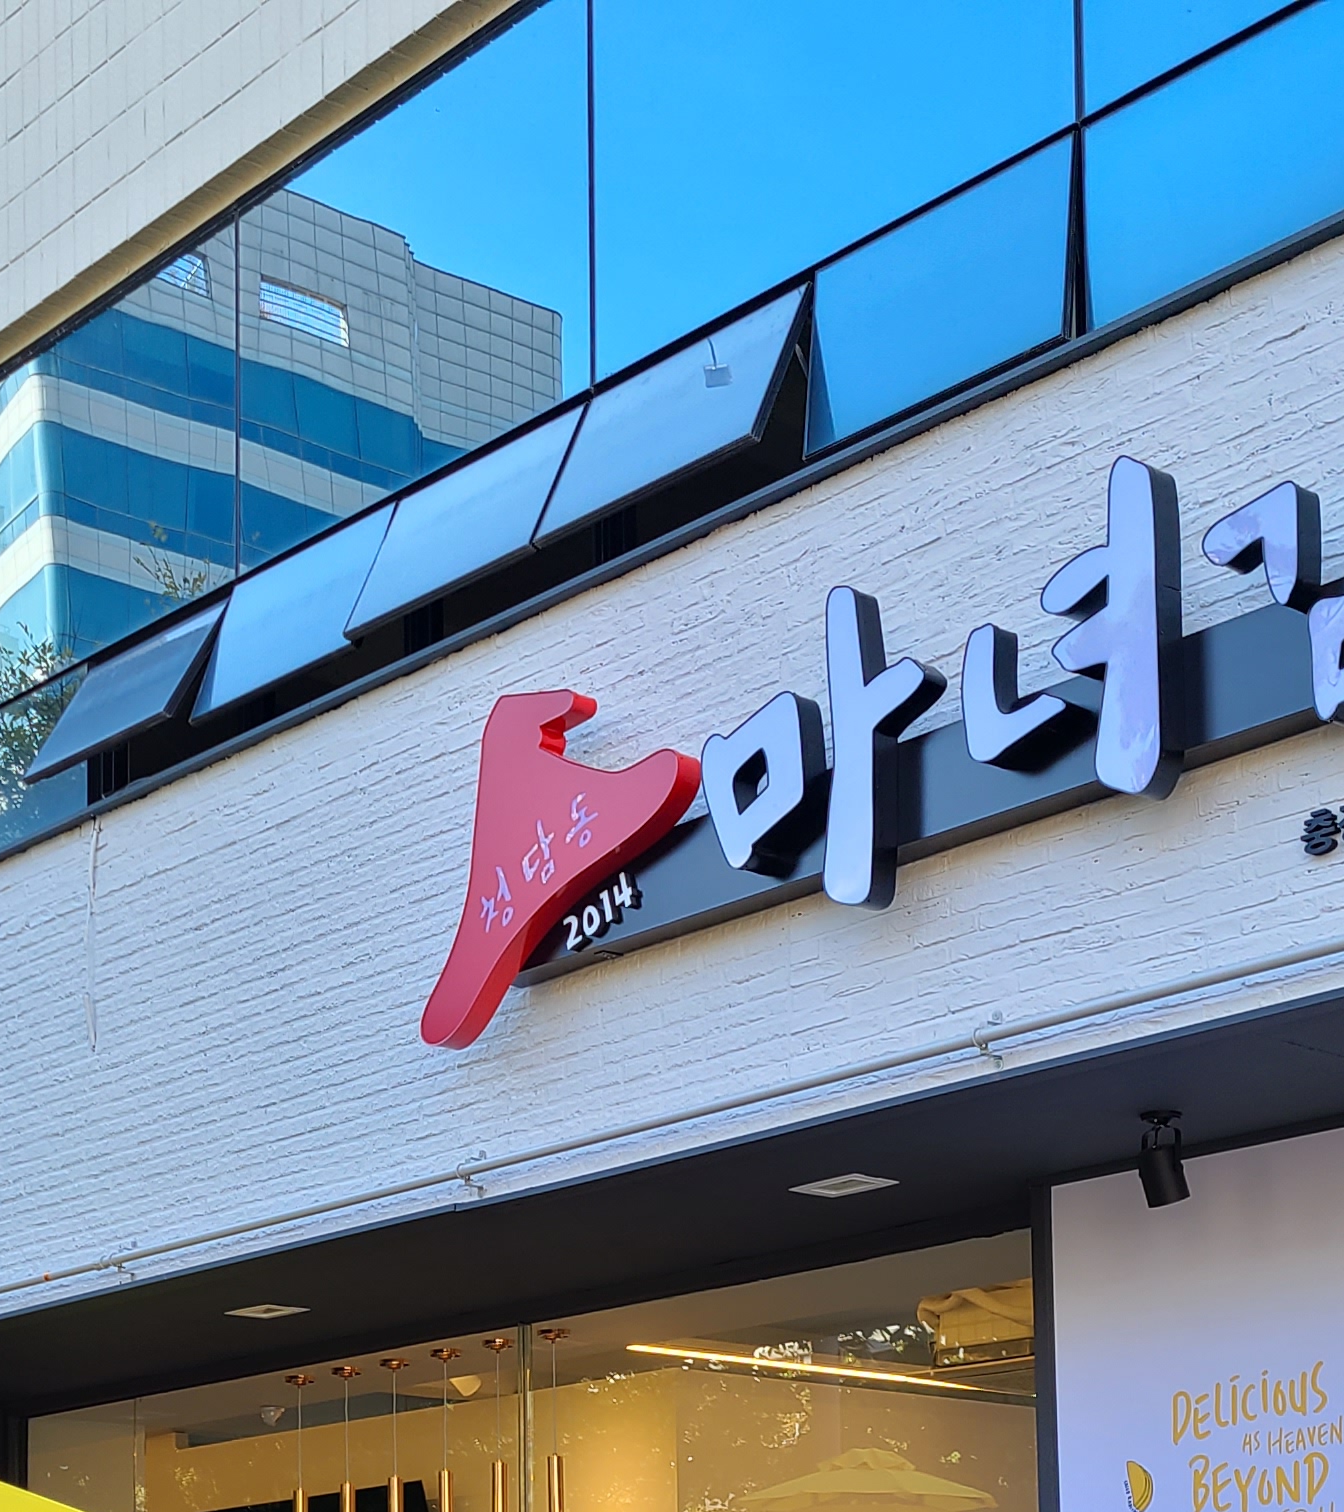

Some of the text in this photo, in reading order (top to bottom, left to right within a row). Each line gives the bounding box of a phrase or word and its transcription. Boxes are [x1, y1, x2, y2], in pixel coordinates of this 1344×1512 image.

[562, 872, 636, 951] 2014
[1172, 1360, 1328, 1446] DELICIOUS
[1242, 1415, 1343, 1456] AS HEAVEN
